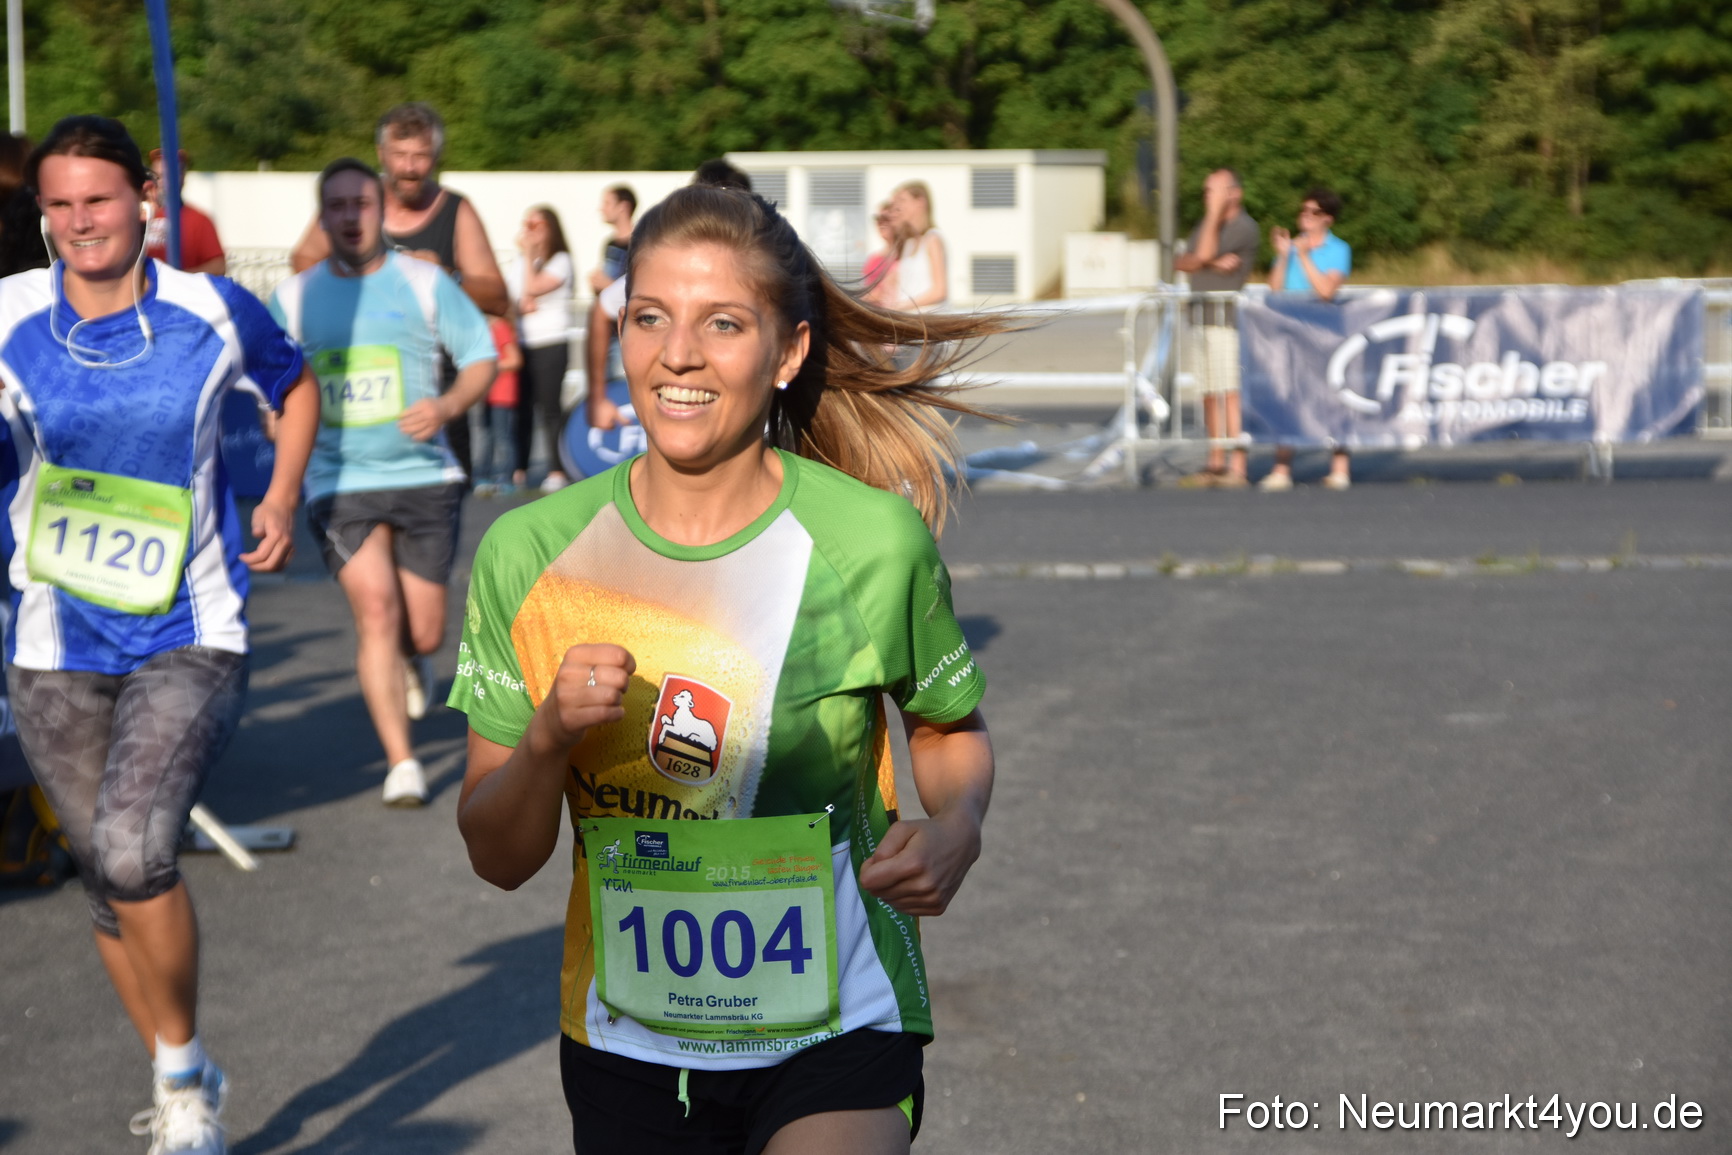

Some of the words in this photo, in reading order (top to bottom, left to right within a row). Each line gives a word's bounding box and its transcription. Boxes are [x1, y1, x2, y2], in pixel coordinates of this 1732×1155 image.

[1376, 350, 1607, 399] Fischer
[322, 375, 391, 406] 1427
[1402, 398, 1589, 421] AUTOMOBILE
[48, 516, 166, 577] 1120
[666, 757, 701, 778] 1628
[622, 853, 702, 872] firmenlauf
[705, 865, 751, 881] 2015
[618, 905, 813, 979] 1004
[877, 897, 928, 1009] Verantwortun
[667, 992, 704, 1008] Petra
[705, 994, 758, 1008] Gruber
[663, 1010, 704, 1021] Neumarkter
[704, 1011, 750, 1021] Lammsbräu
[751, 1012, 763, 1021] KG
